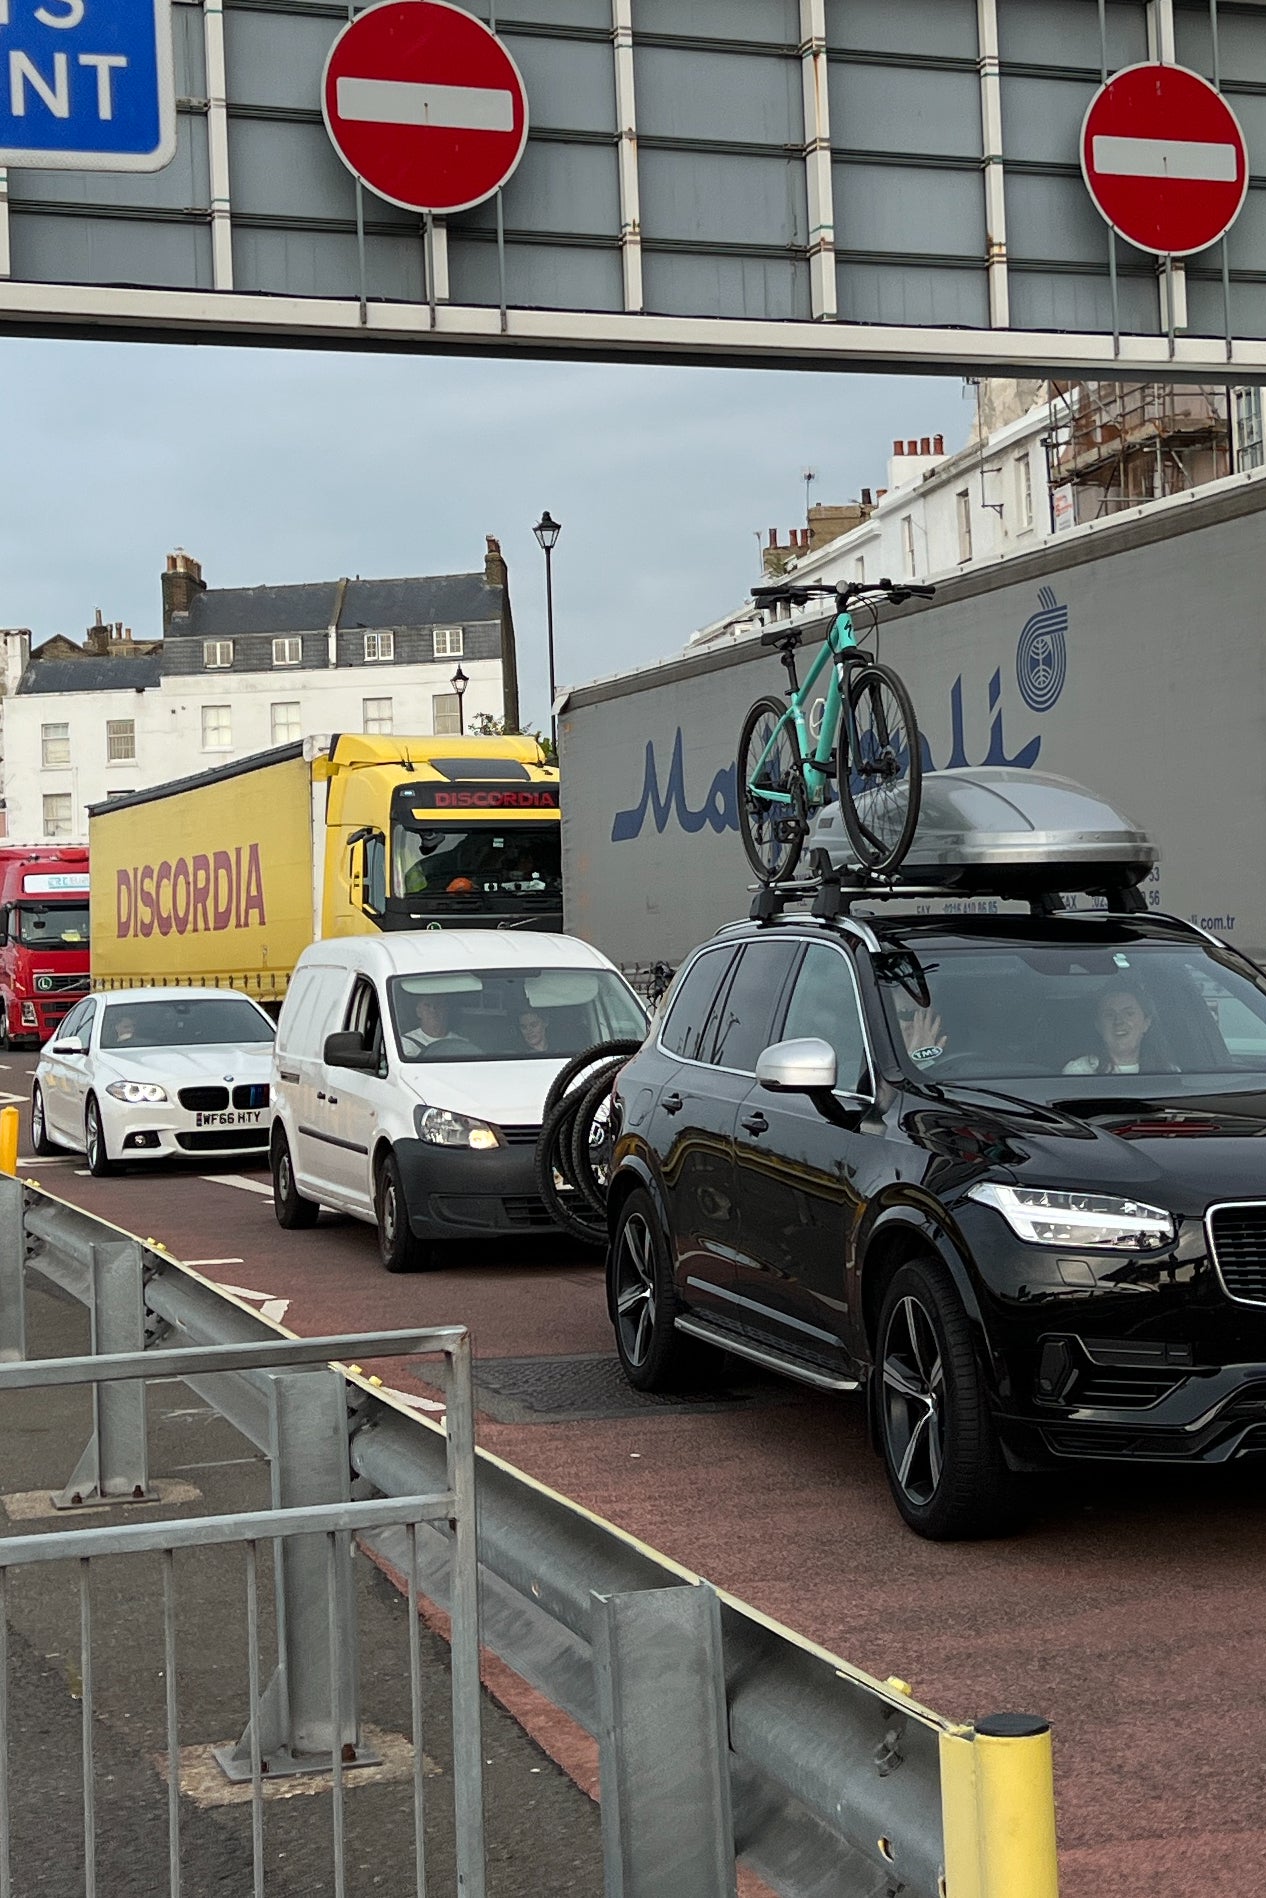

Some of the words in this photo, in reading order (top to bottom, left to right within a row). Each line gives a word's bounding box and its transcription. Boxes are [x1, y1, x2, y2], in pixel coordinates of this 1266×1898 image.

[434, 792, 555, 807] DISCORDIA
[116, 843, 266, 938] DISCORDIA
[203, 1112, 235, 1125] WF66
[238, 1111, 260, 1124] HTY
